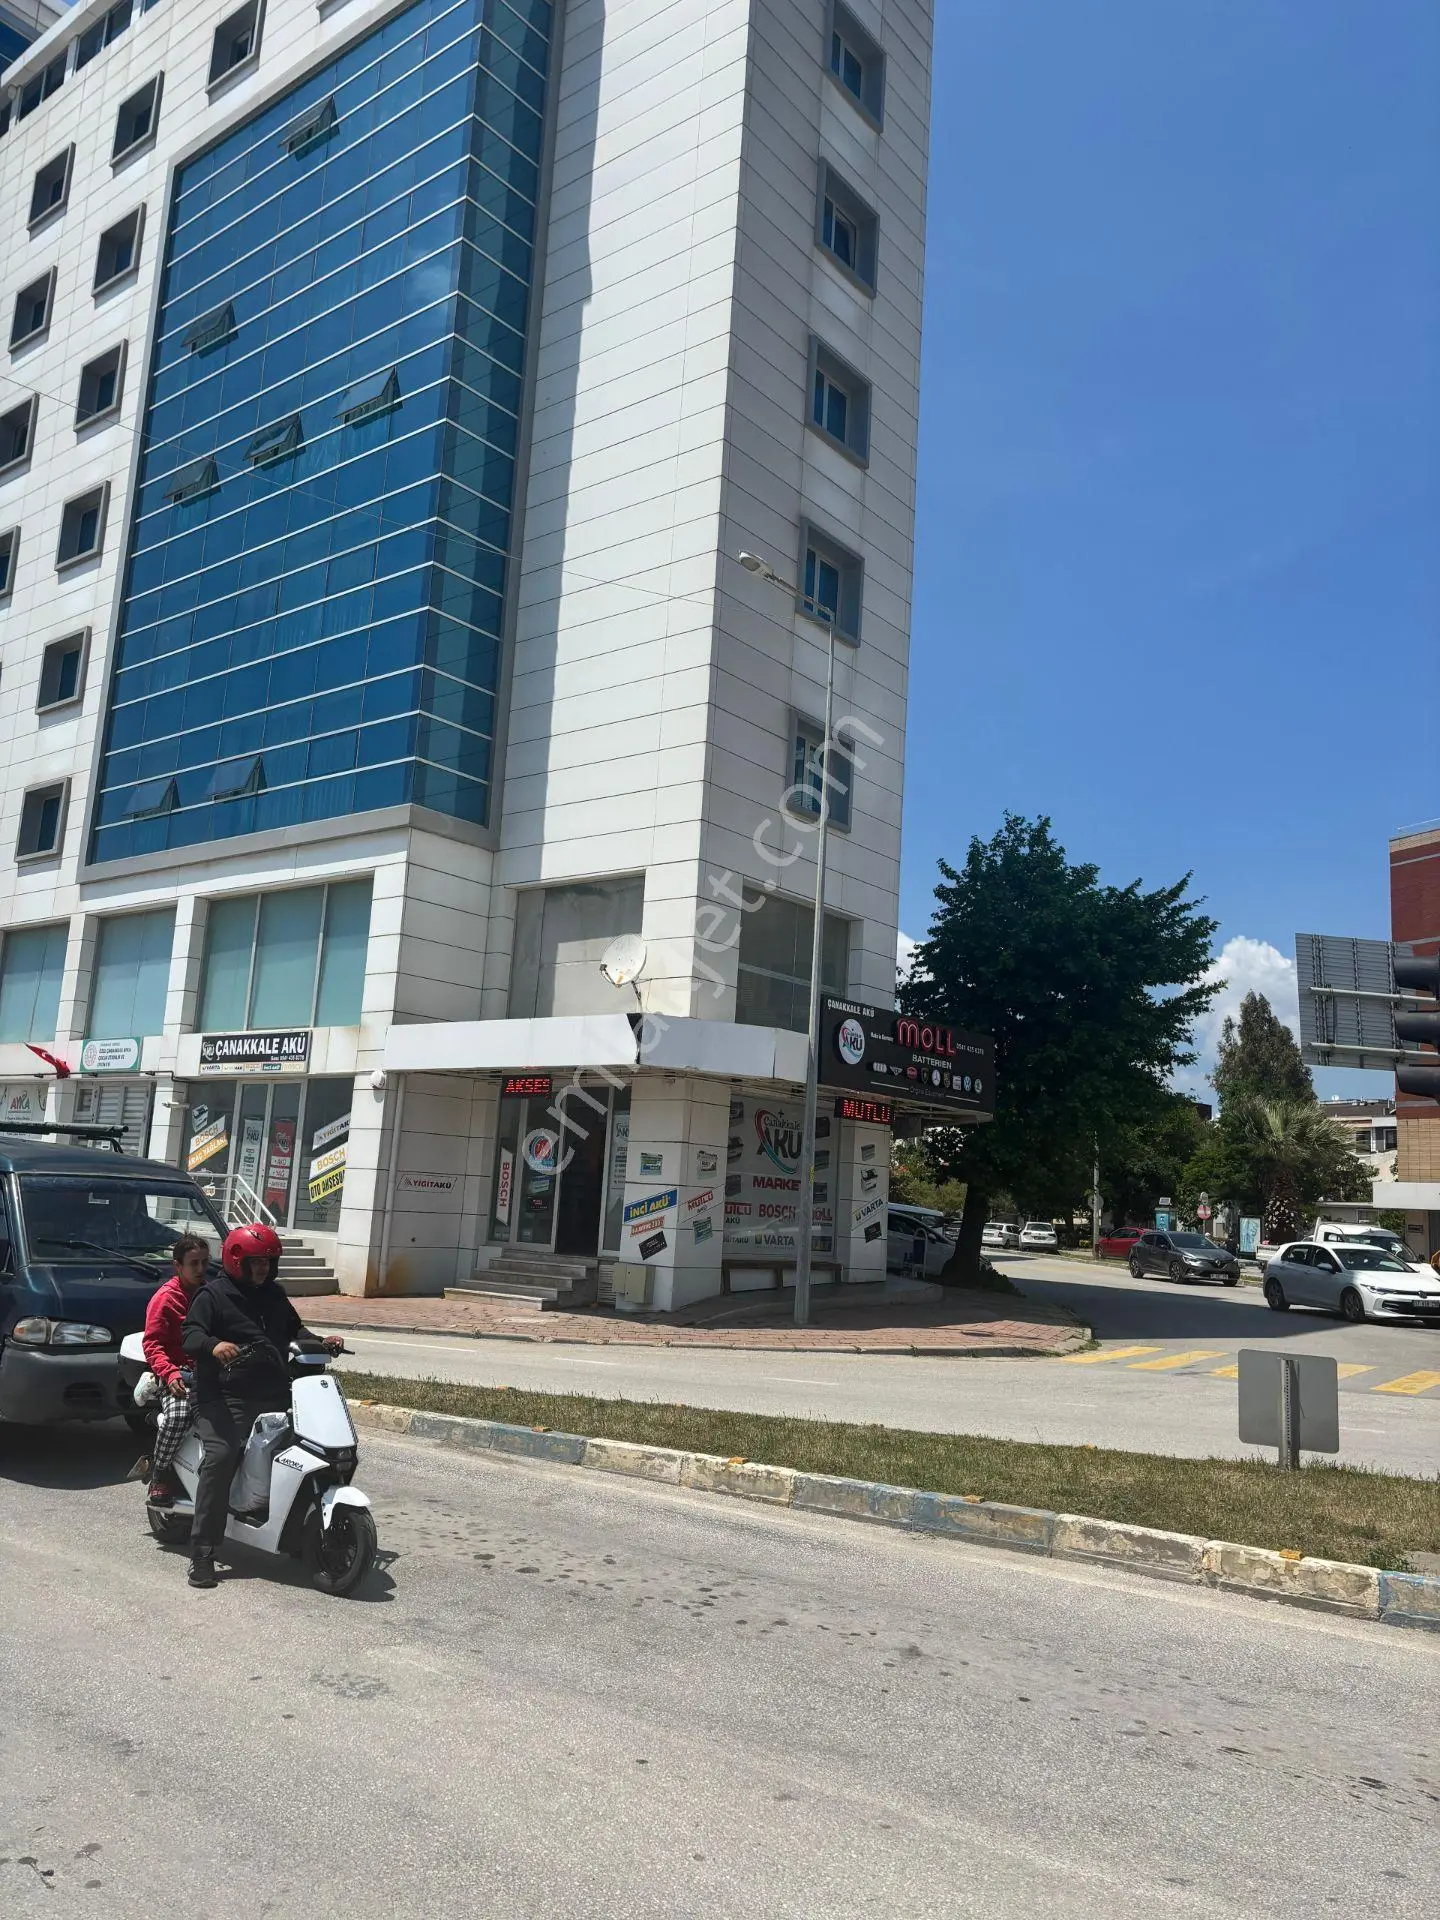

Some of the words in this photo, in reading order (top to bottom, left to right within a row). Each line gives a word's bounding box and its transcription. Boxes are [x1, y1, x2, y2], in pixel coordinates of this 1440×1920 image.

[215, 1037, 280, 1061] ÇANAKKALE
[281, 1032, 306, 1054] AKÜ
[912, 1053, 952, 1070] BATTERIEN
[842, 1099, 891, 1122] MUTLU
[195, 1123, 219, 1147] BOSCH
[317, 1147, 346, 1171] BOSCH
[310, 1183, 321, 1199] OTO
[499, 1161, 510, 1207] BOSCH
[752, 1175, 801, 1191] MARKE
[759, 1203, 796, 1219] BOSCH
[861, 1198, 884, 1217] VARTA
[763, 1234, 795, 1246] VARTA
[281, 1457, 305, 1470] ARORA
